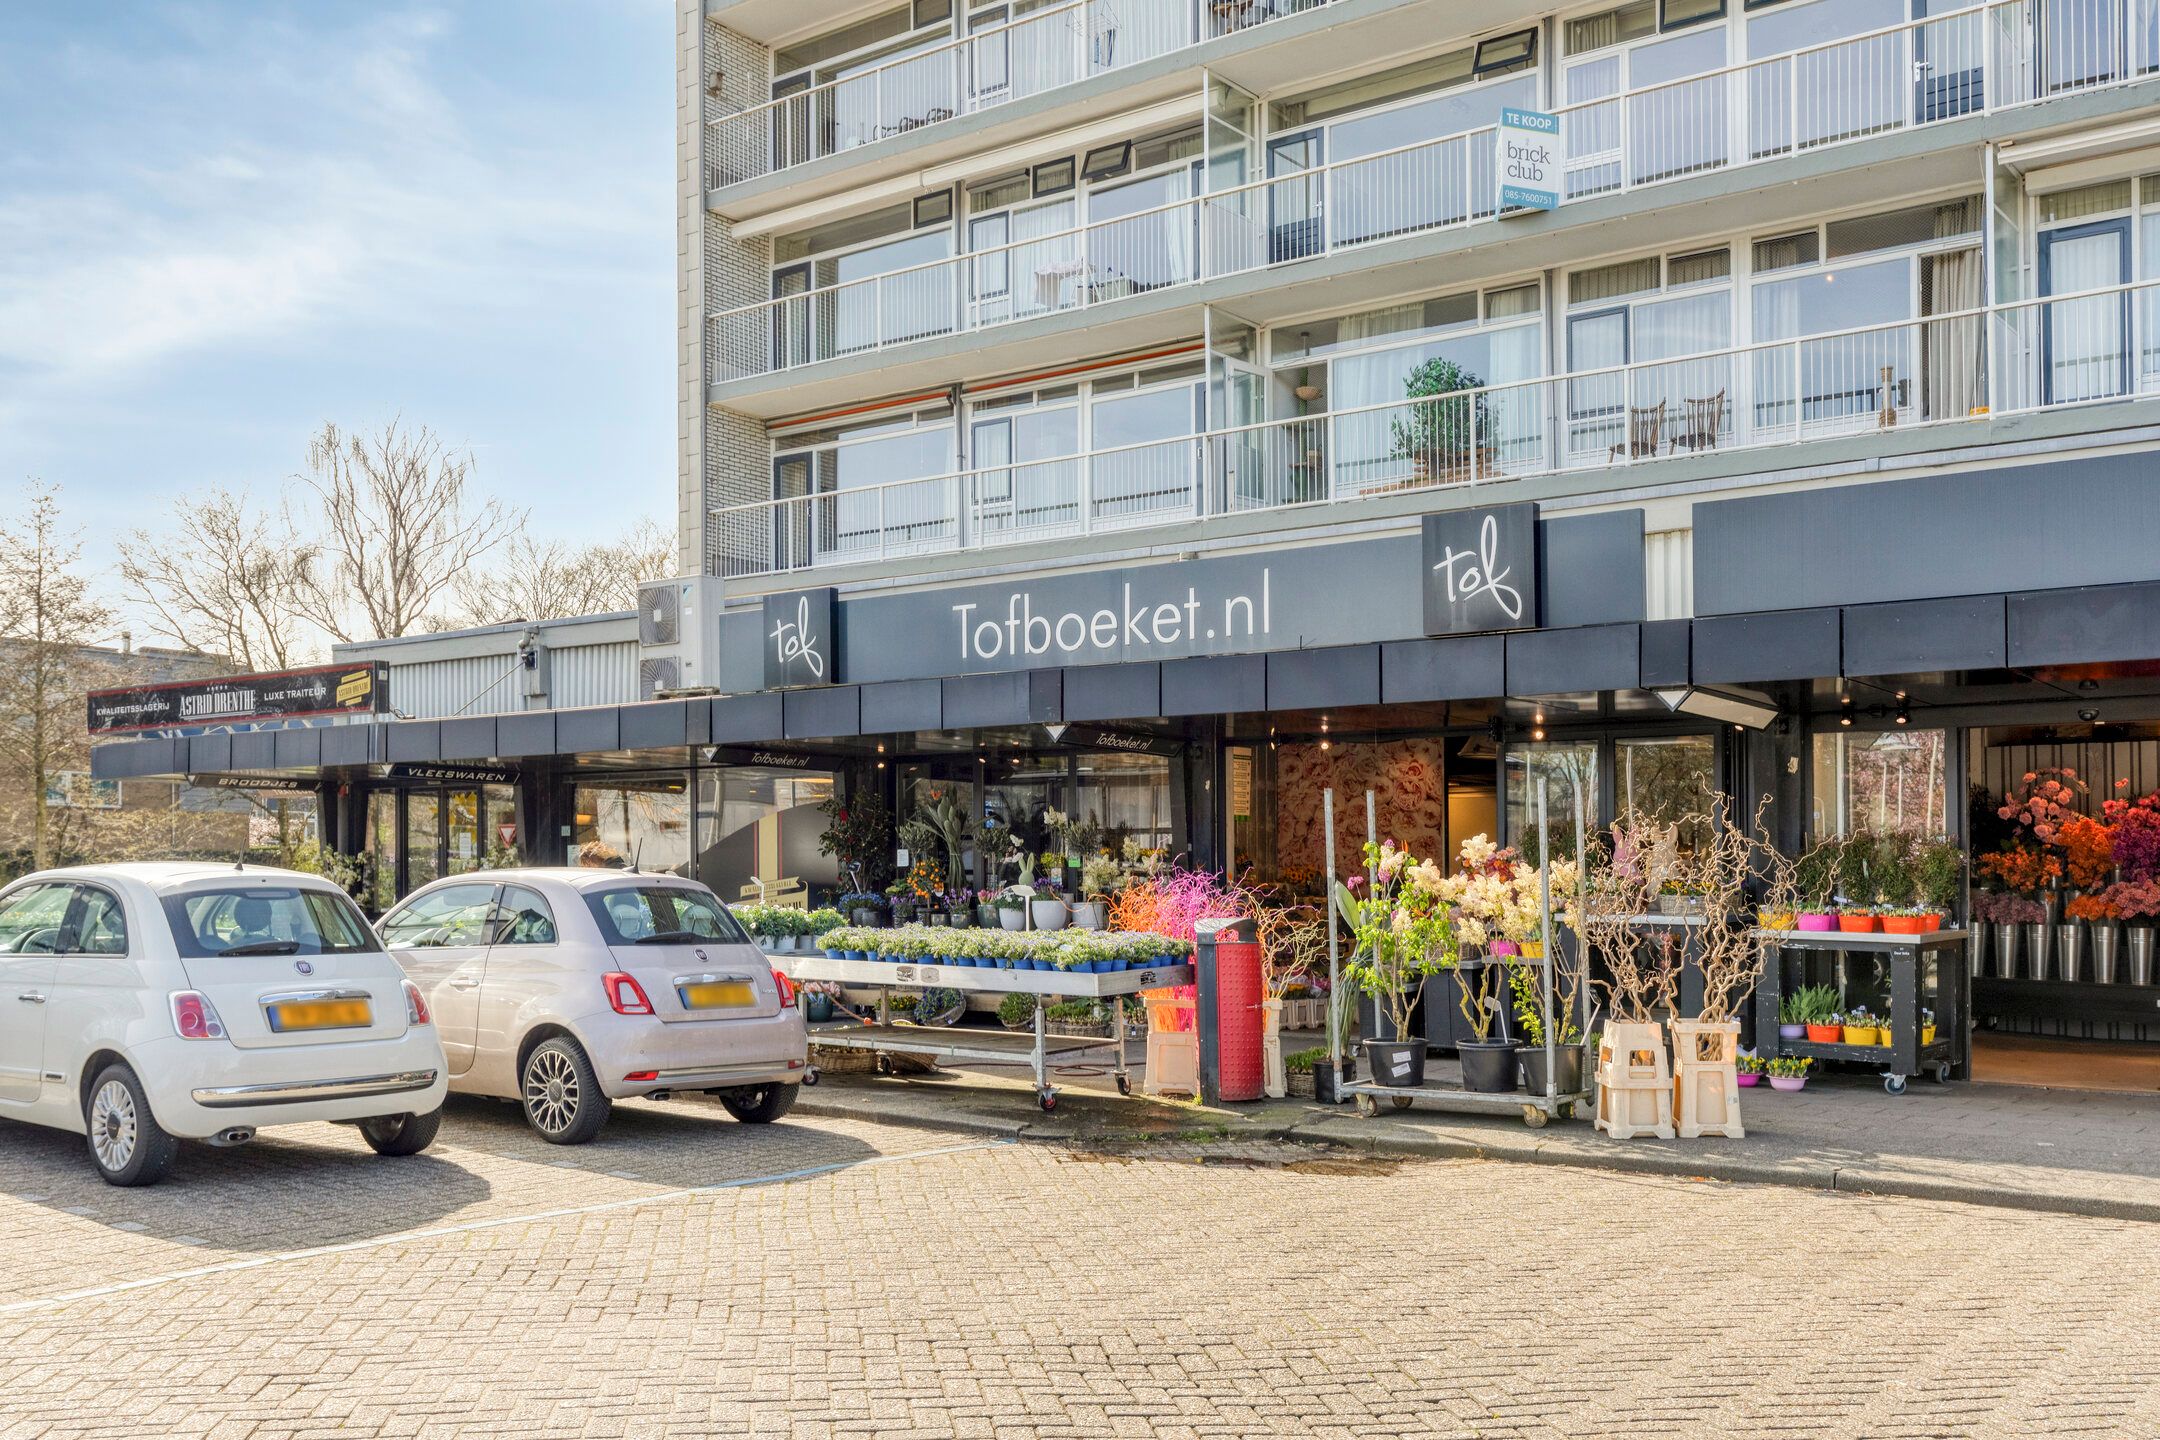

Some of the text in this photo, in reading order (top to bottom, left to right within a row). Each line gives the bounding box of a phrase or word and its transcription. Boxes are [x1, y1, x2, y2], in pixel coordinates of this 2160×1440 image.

[1506, 113, 1552, 129] TE KOOP
[1507, 140, 1551, 164] brick
[1507, 161, 1543, 181] club
[1504, 189, 1552, 204] 085-7600751
[1433, 515, 1522, 620] tof
[952, 568, 1270, 659] Tofboeket.nl
[769, 596, 823, 677] tof
[97, 702, 170, 716] KWALITEITSSLAGERIJ
[179, 694, 213, 716] ASTRID
[214, 689, 256, 713] DRENTHE
[264, 690, 284, 701] LUXE
[286, 686, 327, 699] TRAITEUR
[1095, 732, 1153, 750] Tofboeket.nl
[751, 752, 810, 767] Tofboeket.nl
[218, 778, 298, 788] BROODJES
[408, 768, 505, 781] VLEESWAREN
